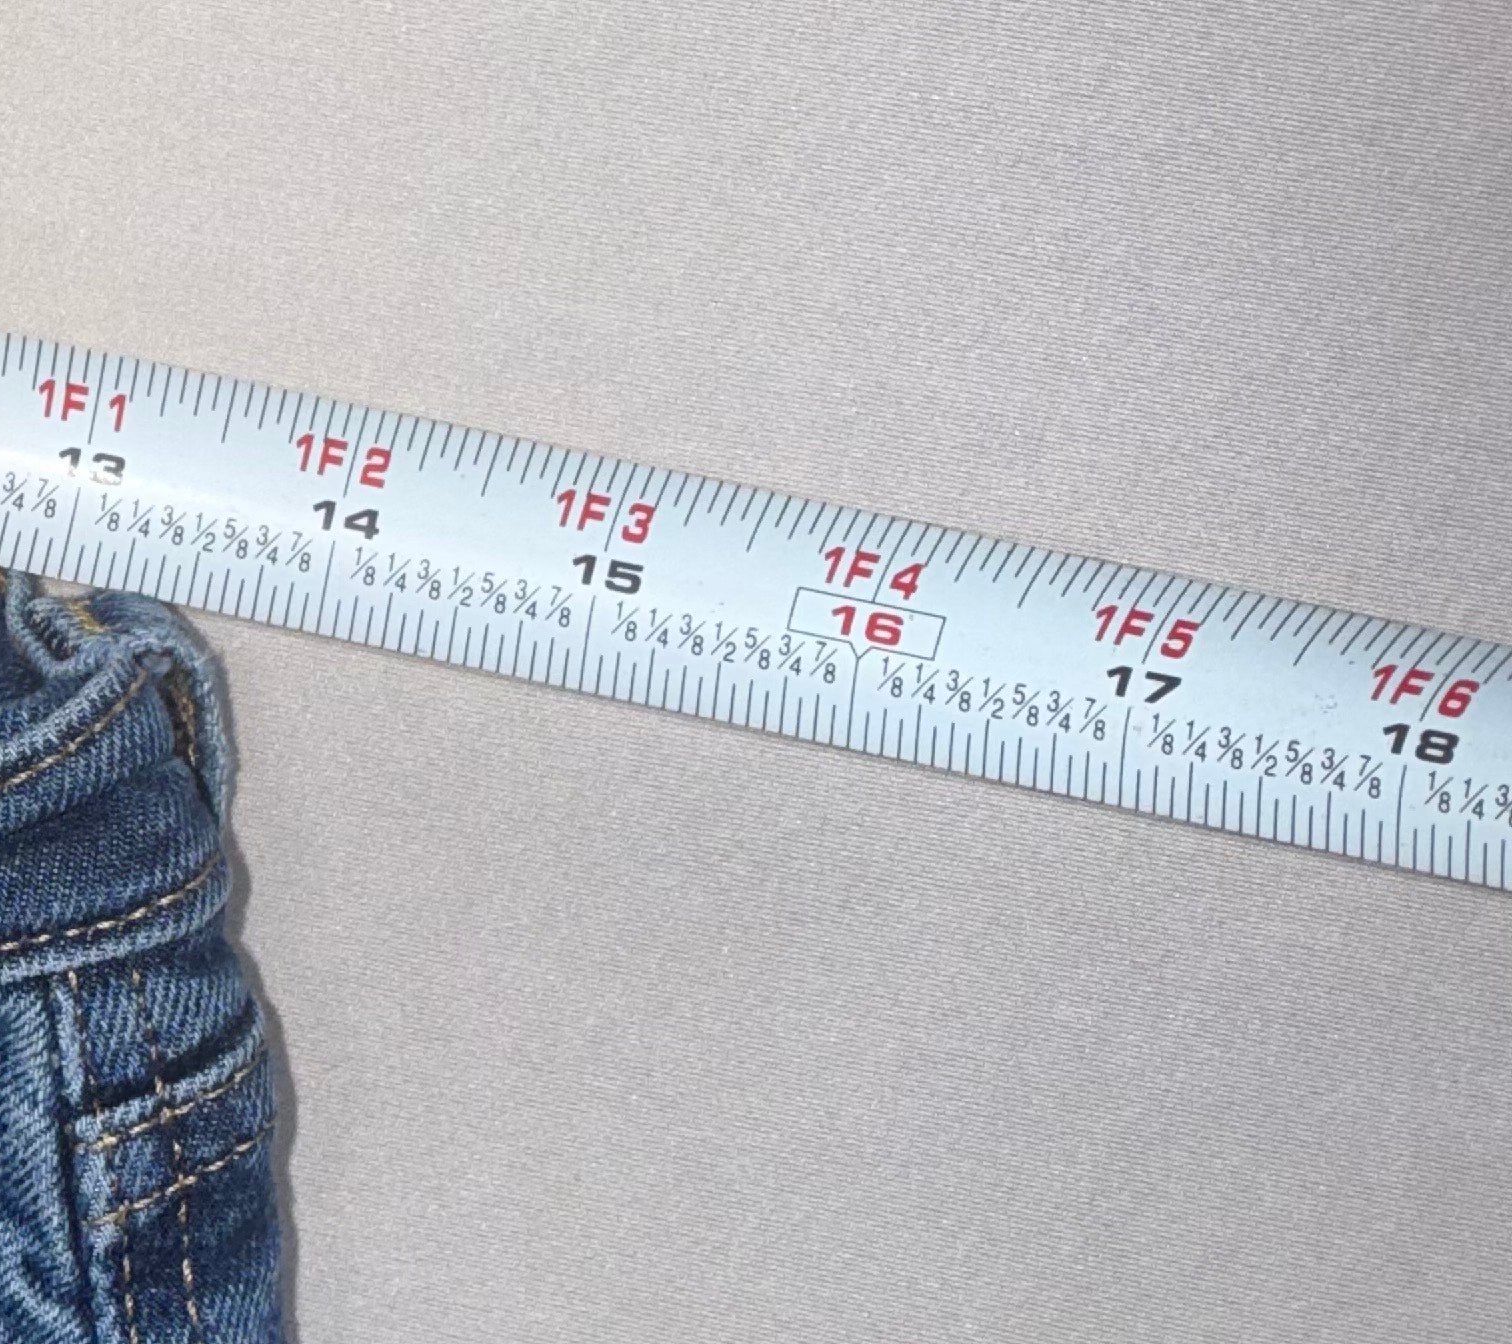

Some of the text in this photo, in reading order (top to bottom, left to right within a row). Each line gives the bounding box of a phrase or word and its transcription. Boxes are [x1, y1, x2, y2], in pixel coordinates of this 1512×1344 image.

[39, 379, 127, 432] 1F 1
[59, 447, 125, 486] 13
[296, 434, 391, 488] 1F 2
[313, 500, 379, 539] 14
[557, 489, 655, 543] 1F 3
[573, 555, 643, 594] 15
[825, 547, 927, 599] 1F 4
[832, 606, 904, 645] 16
[1095, 605, 1200, 659] 1F 5
[1107, 666, 1182, 703] 17
[1371, 664, 1480, 717] 1F 6
[1383, 724, 1460, 764] 18
